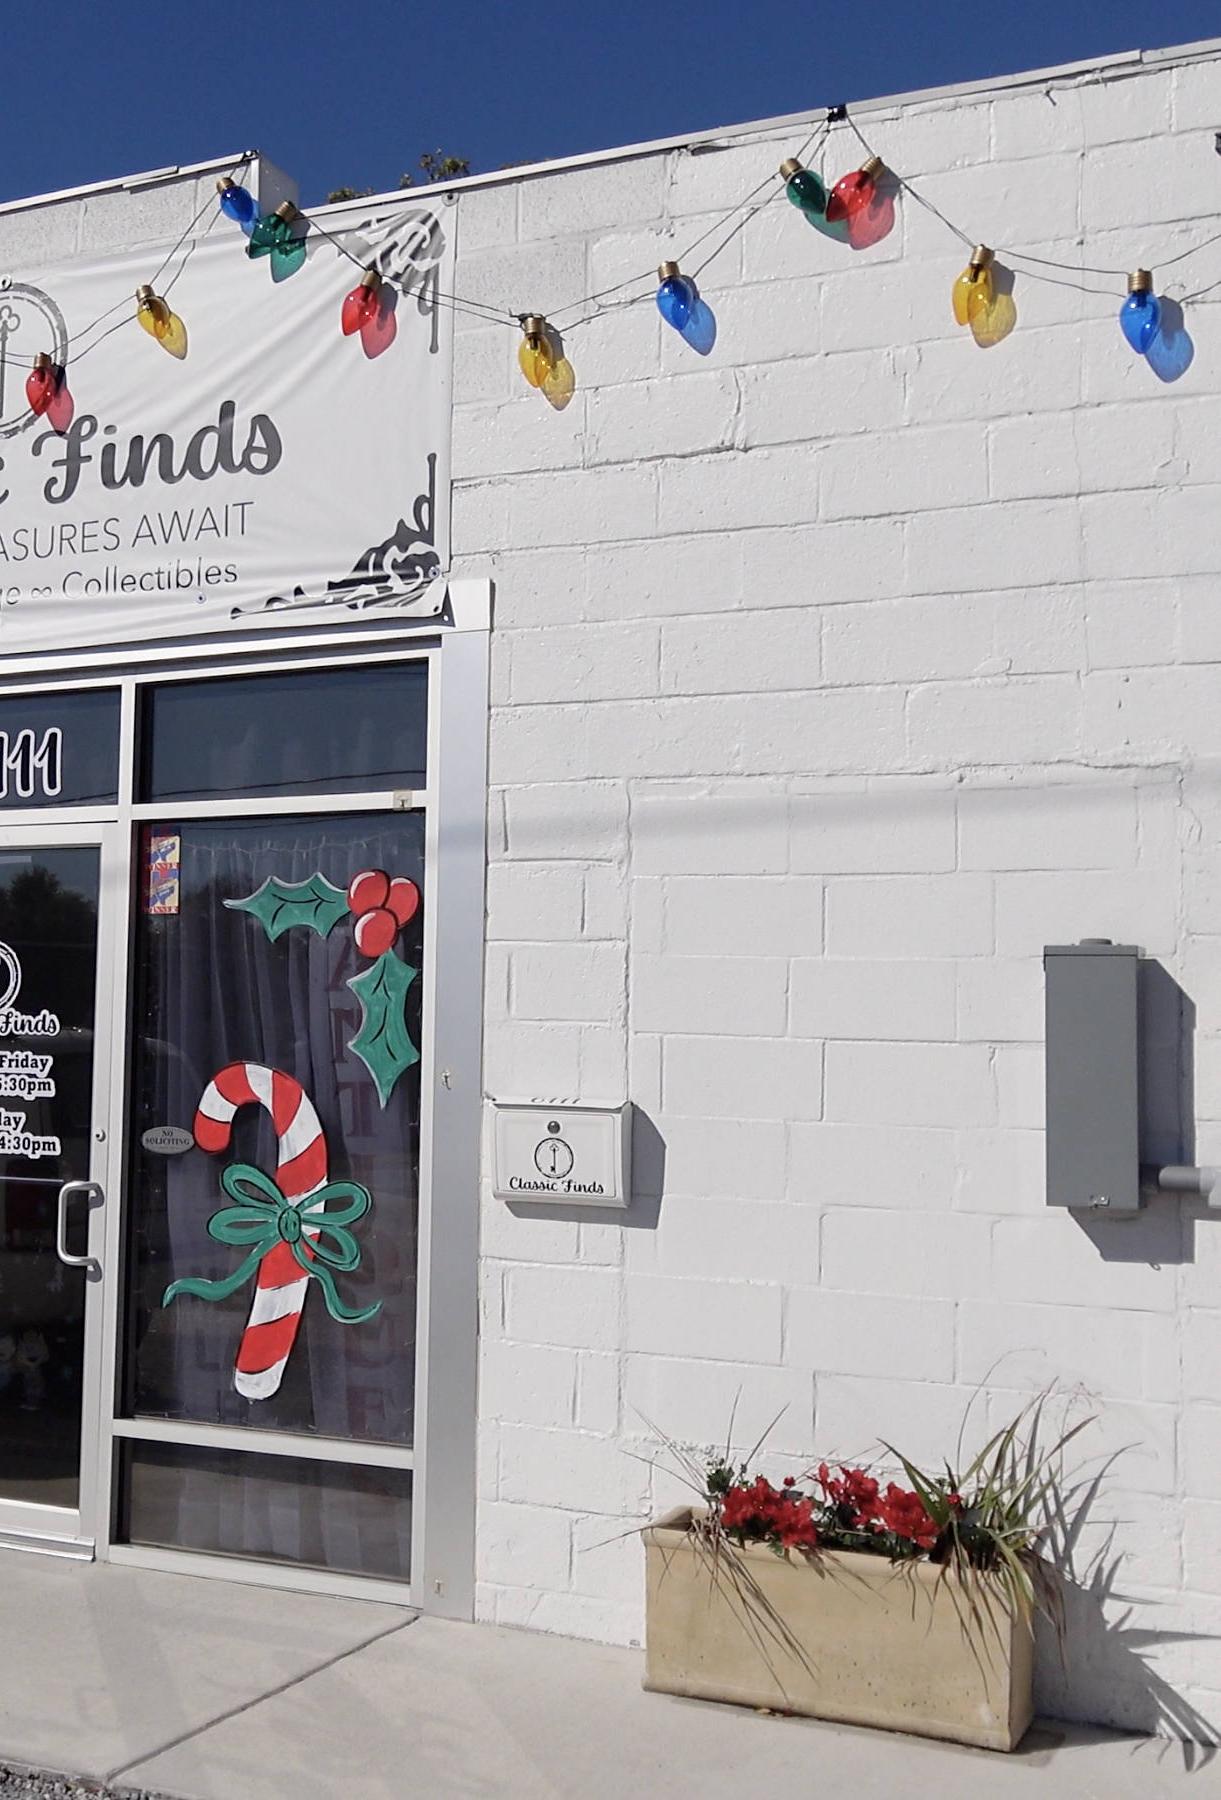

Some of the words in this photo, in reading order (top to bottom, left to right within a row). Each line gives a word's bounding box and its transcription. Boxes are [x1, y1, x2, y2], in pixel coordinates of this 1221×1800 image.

[31, 400, 284, 504] Finds
[131, 501, 255, 549] AWAIT
[61, 556, 239, 599] Collectibles
[145, 1137, 190, 1146] SOLICITING
[162, 1130, 174, 1138] NO
[509, 1176, 559, 1192] Classic
[561, 1178, 604, 1194] Finds
